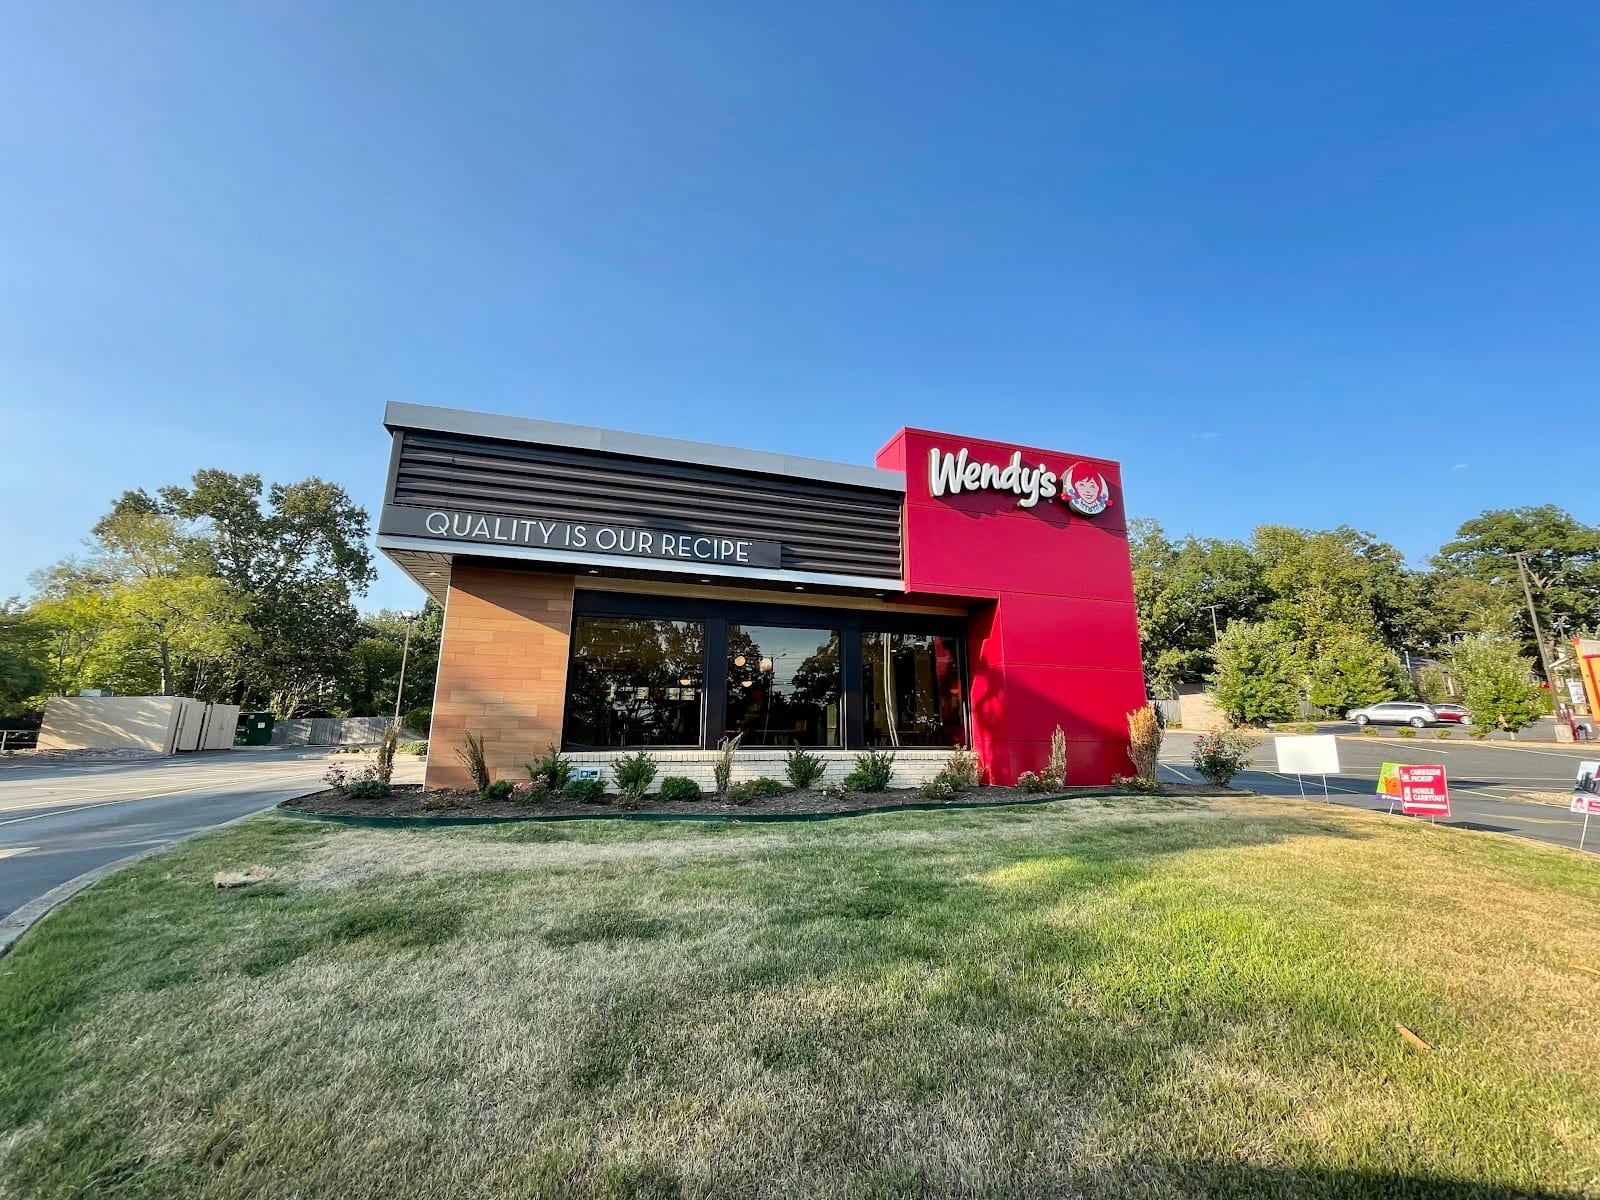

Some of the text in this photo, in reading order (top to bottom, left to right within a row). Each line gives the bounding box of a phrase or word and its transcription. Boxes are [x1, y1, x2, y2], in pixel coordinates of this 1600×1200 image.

[929, 447, 1056, 508] Wendy's
[425, 511, 555, 546] QUALITY
[564, 524, 587, 547] IS
[596, 528, 653, 554] OUR
